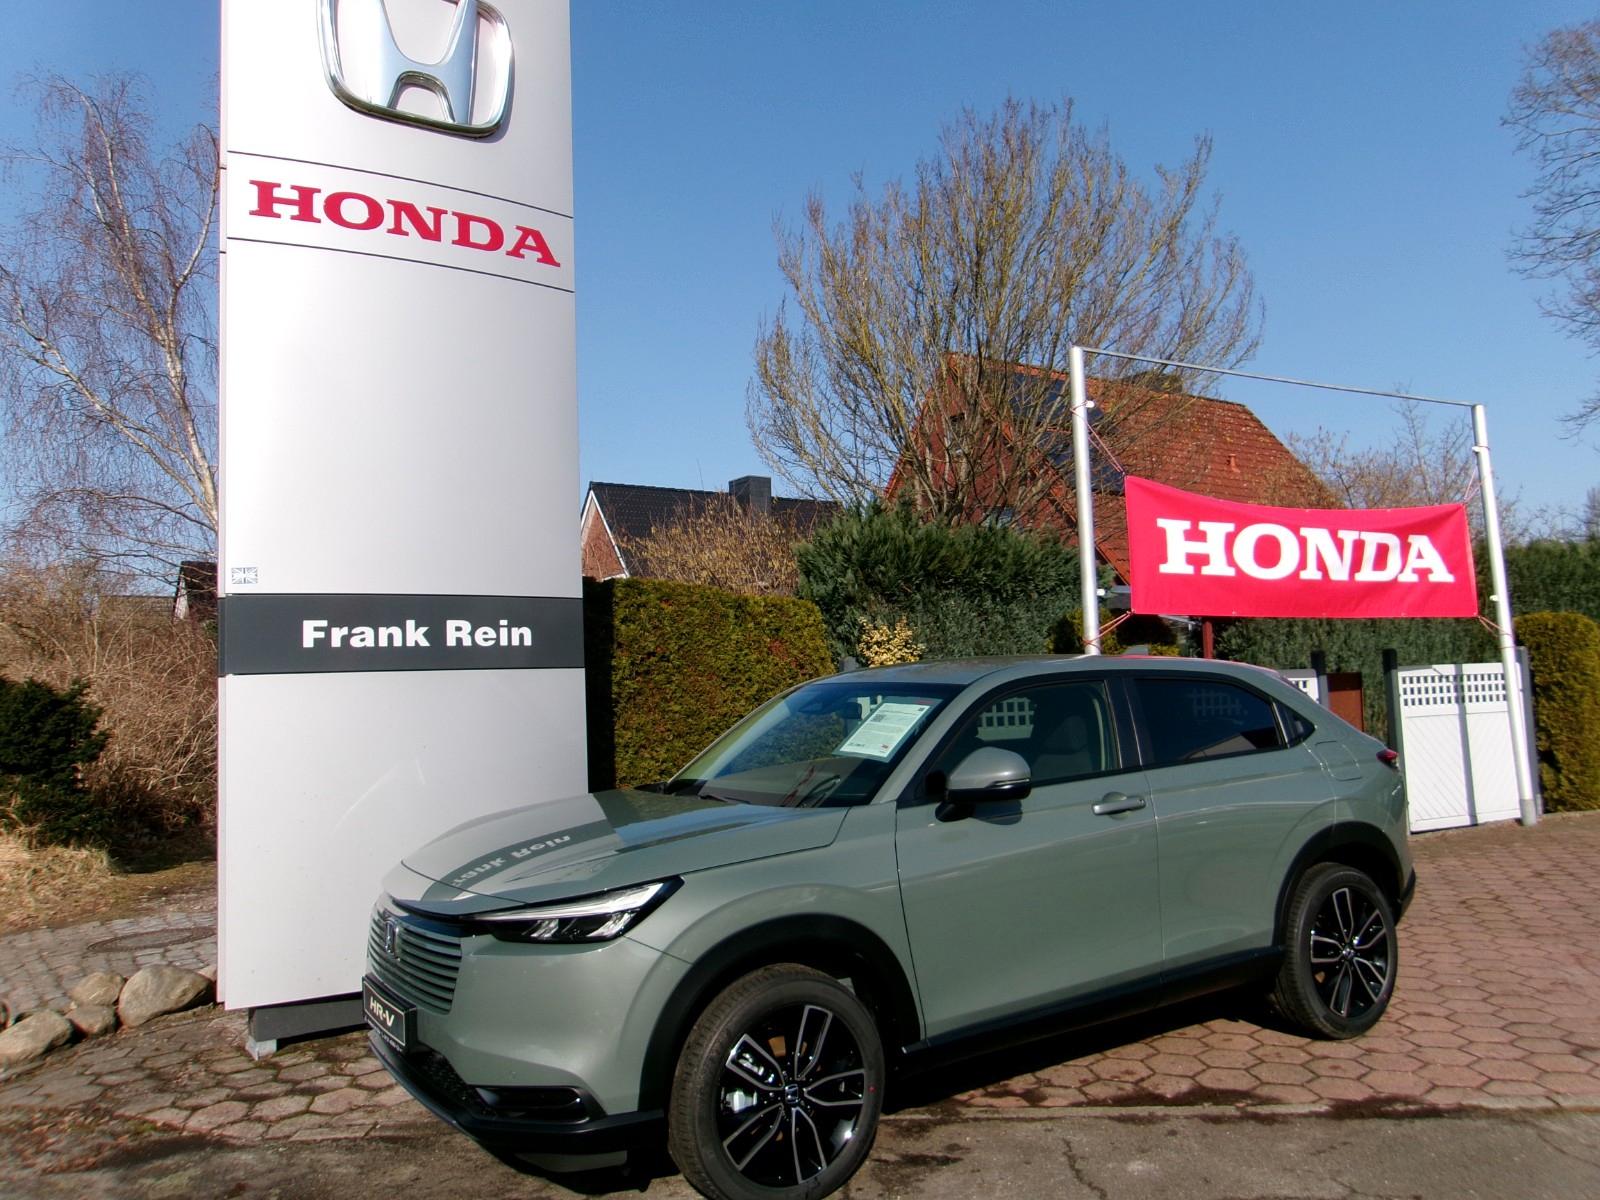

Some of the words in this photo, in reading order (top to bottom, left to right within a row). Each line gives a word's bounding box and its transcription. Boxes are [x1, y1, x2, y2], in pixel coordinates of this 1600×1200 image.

[249, 179, 561, 268] HONDA
[1156, 517, 1455, 583] HONDA
[302, 619, 431, 648] Frank
[446, 619, 532, 647] Rein
[369, 996, 395, 1027] HR-V
